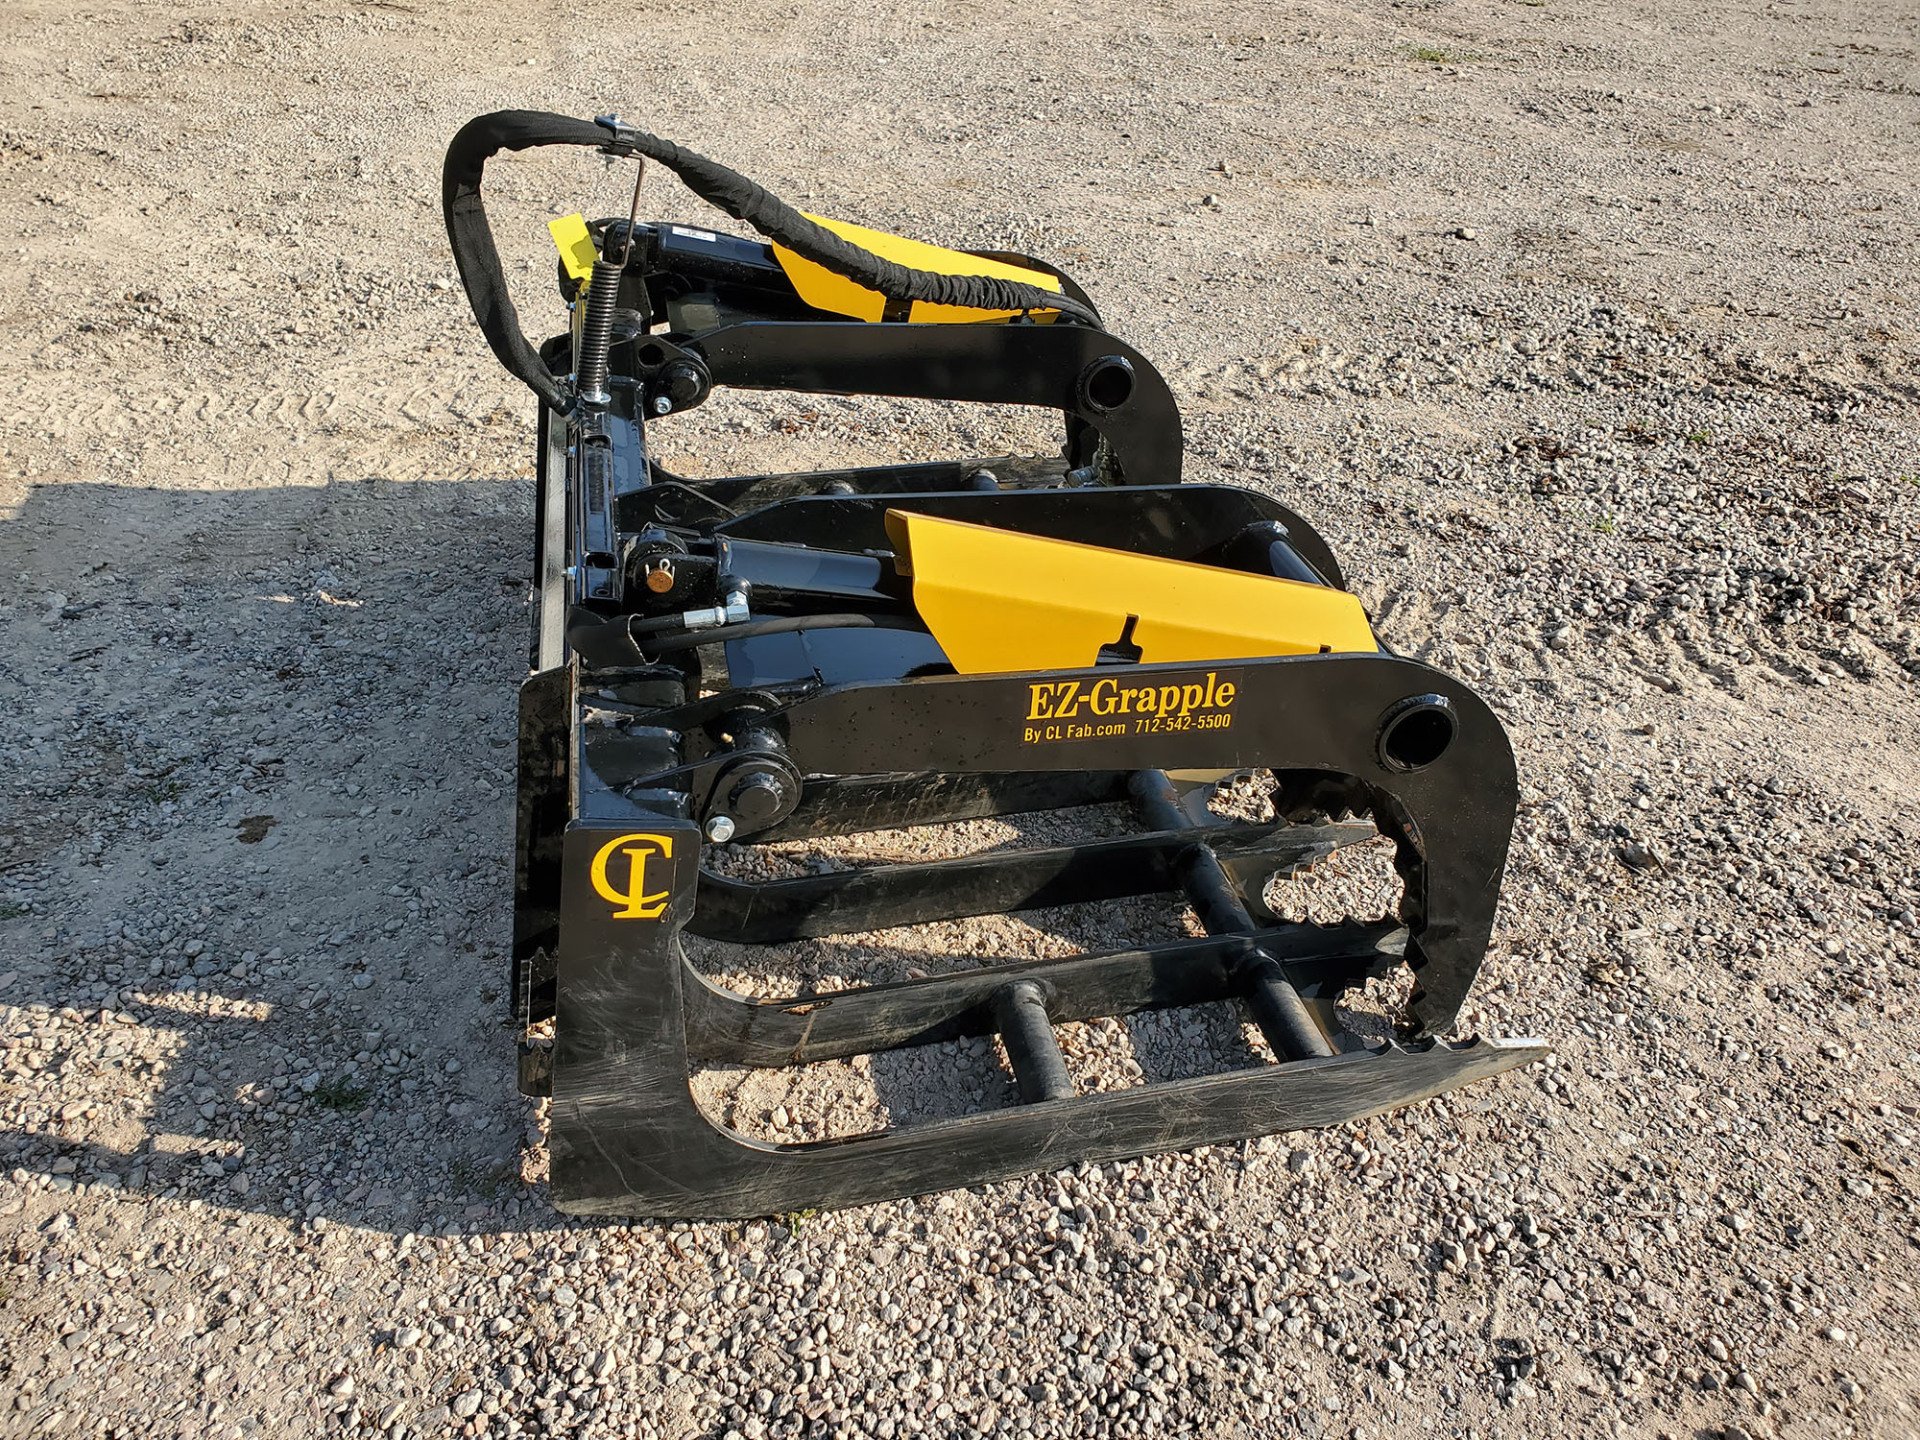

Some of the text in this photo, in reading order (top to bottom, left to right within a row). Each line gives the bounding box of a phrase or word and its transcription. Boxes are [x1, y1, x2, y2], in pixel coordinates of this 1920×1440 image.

[1025, 672, 1236, 719] EZ-Grapple
[1024, 713, 1231, 743] By CL Fab.com 712-542-5500
